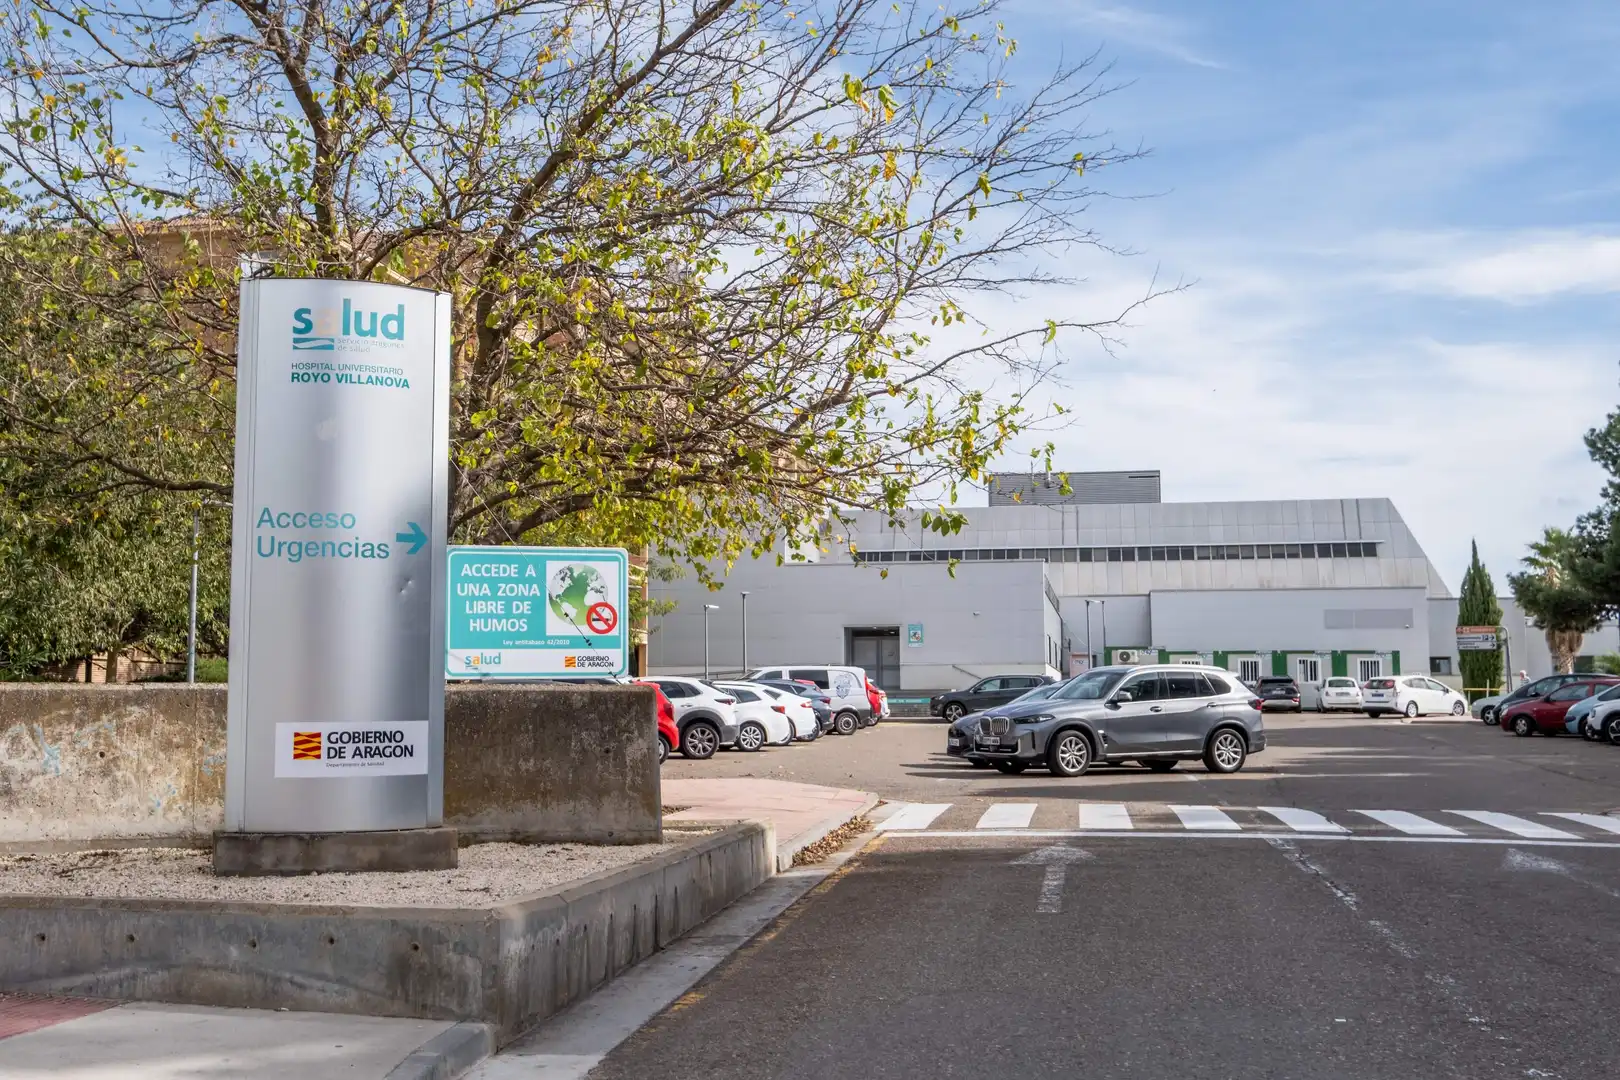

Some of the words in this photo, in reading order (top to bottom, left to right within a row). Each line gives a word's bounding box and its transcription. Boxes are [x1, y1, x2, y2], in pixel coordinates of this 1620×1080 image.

[292, 298, 405, 340] salud
[291, 362, 335, 371] HOSPITAL
[338, 363, 403, 376] UNIVERSITARIO
[291, 372, 331, 383] ROYO
[336, 373, 410, 389] VILLANOVA
[256, 507, 356, 529] Acceso
[257, 536, 389, 563] Urgencias
[461, 563, 518, 577] ACCEDE
[525, 564, 536, 577] A
[457, 583, 491, 597] UNA
[497, 583, 540, 597] ZONA
[465, 601, 505, 614] LIBRE
[512, 601, 531, 614] DE
[469, 619, 528, 632] HUMOS
[464, 652, 501, 665] salud
[327, 730, 404, 744] GOBIERNO
[327, 746, 346, 759] DE
[352, 745, 414, 759] ARAGON
